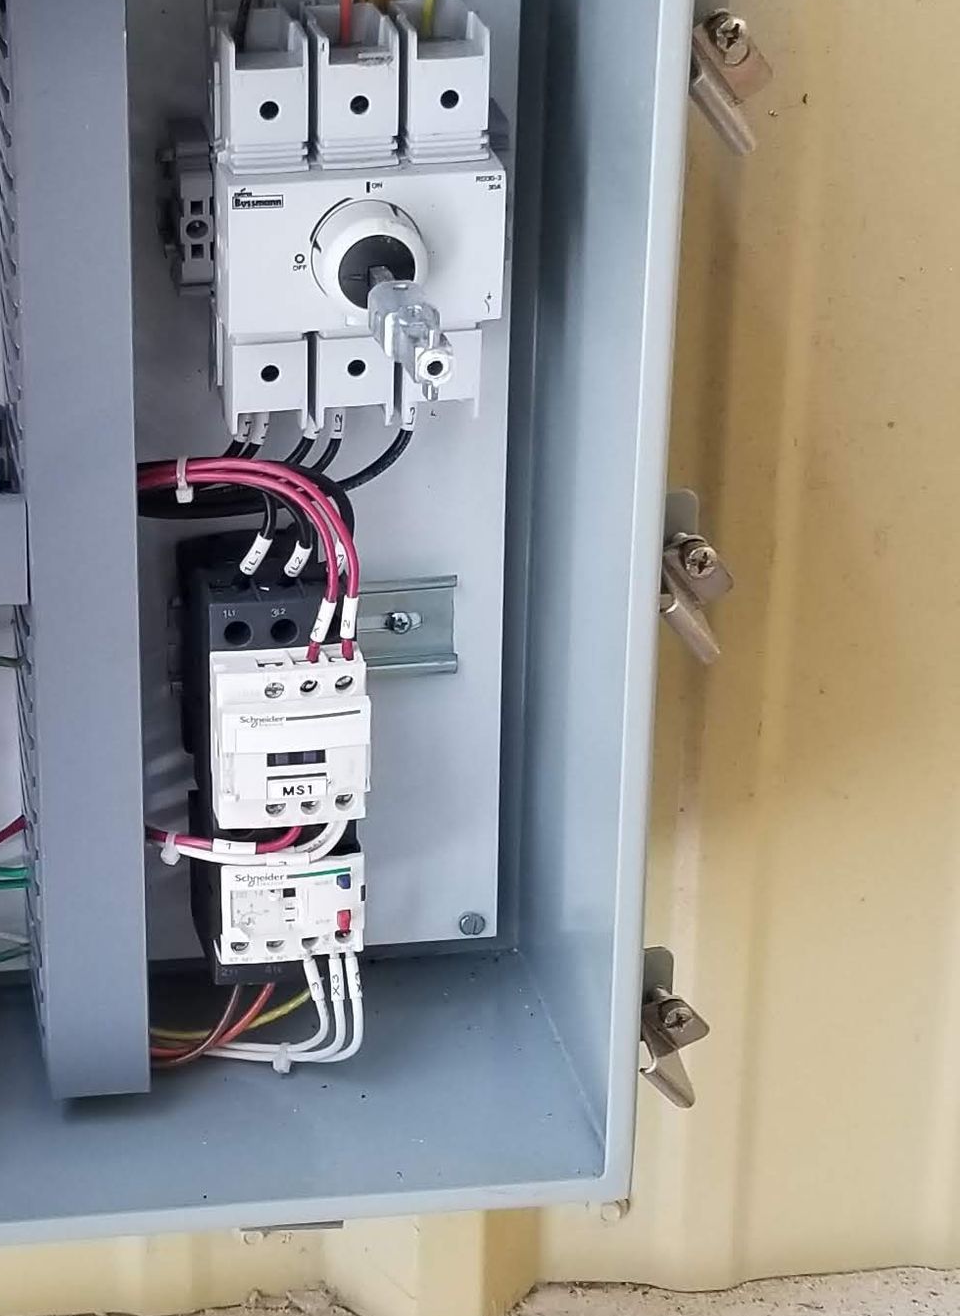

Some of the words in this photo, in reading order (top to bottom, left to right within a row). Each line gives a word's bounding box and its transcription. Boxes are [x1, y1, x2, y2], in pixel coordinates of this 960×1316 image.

[371, 181, 383, 189] ON
[234, 196, 282, 208] Bussmann
[333, 413, 343, 433] L2
[405, 406, 416, 425] L3
[244, 550, 261, 572] 1L1
[288, 556, 304, 575] 1L2
[239, 715, 286, 728] Schneider
[283, 784, 314, 797] MS1
[234, 872, 285, 887] Schneider
[332, 973, 341, 996] X3
